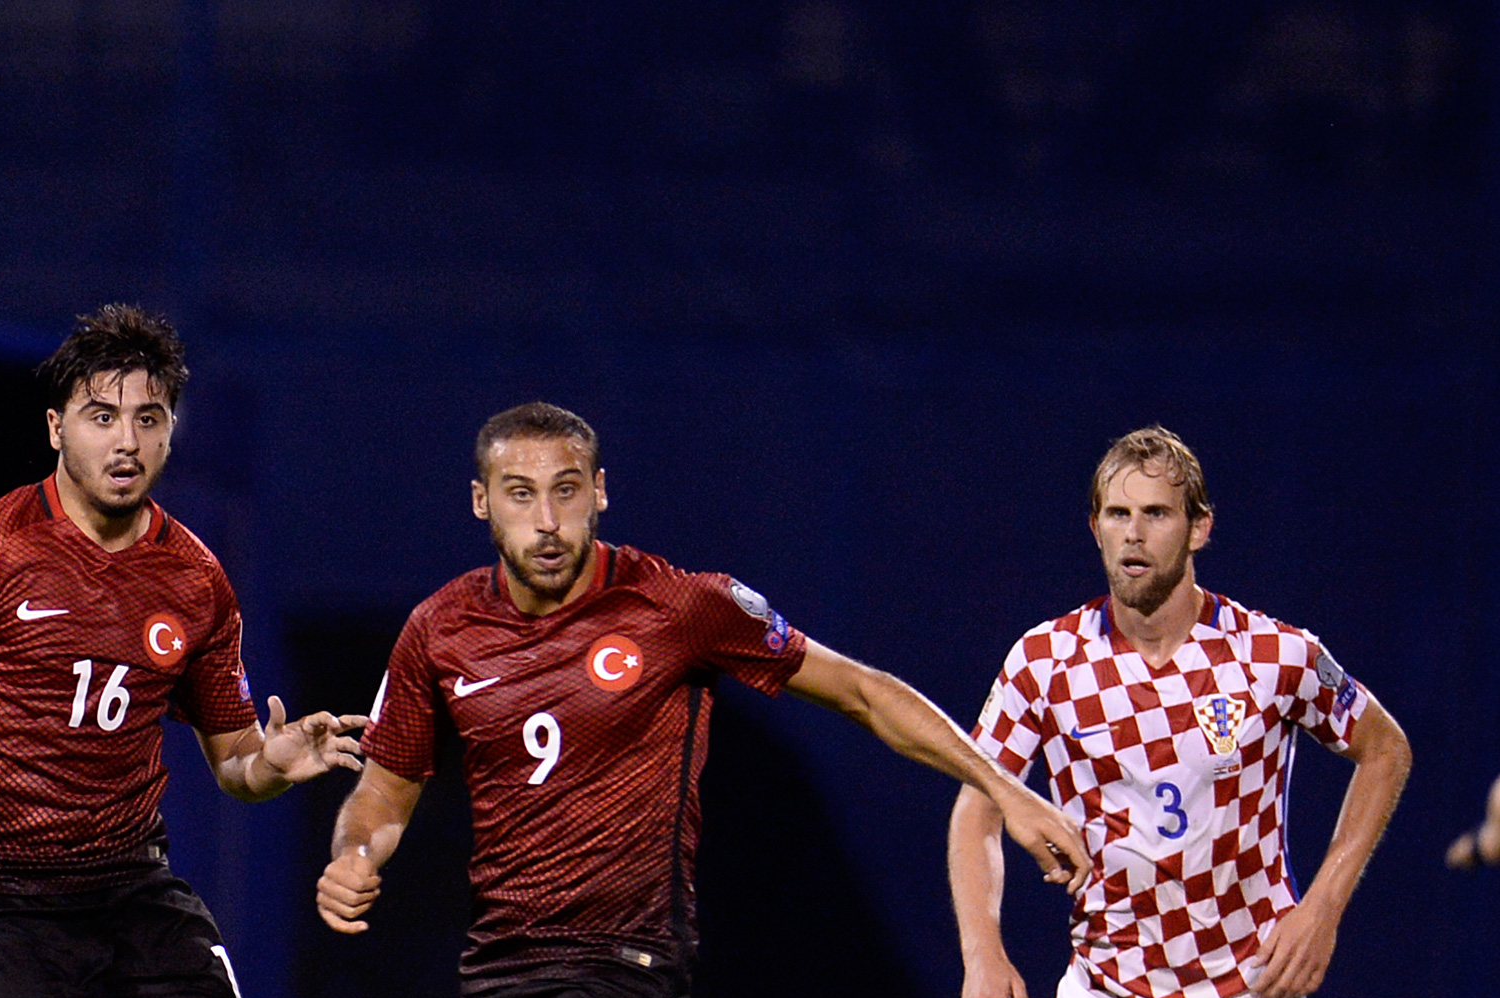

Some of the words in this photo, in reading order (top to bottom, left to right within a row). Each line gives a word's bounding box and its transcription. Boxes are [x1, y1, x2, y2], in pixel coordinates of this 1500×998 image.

[68, 659, 130, 732] 16
[523, 712, 561, 785] 9
[1155, 781, 1189, 840] 3
